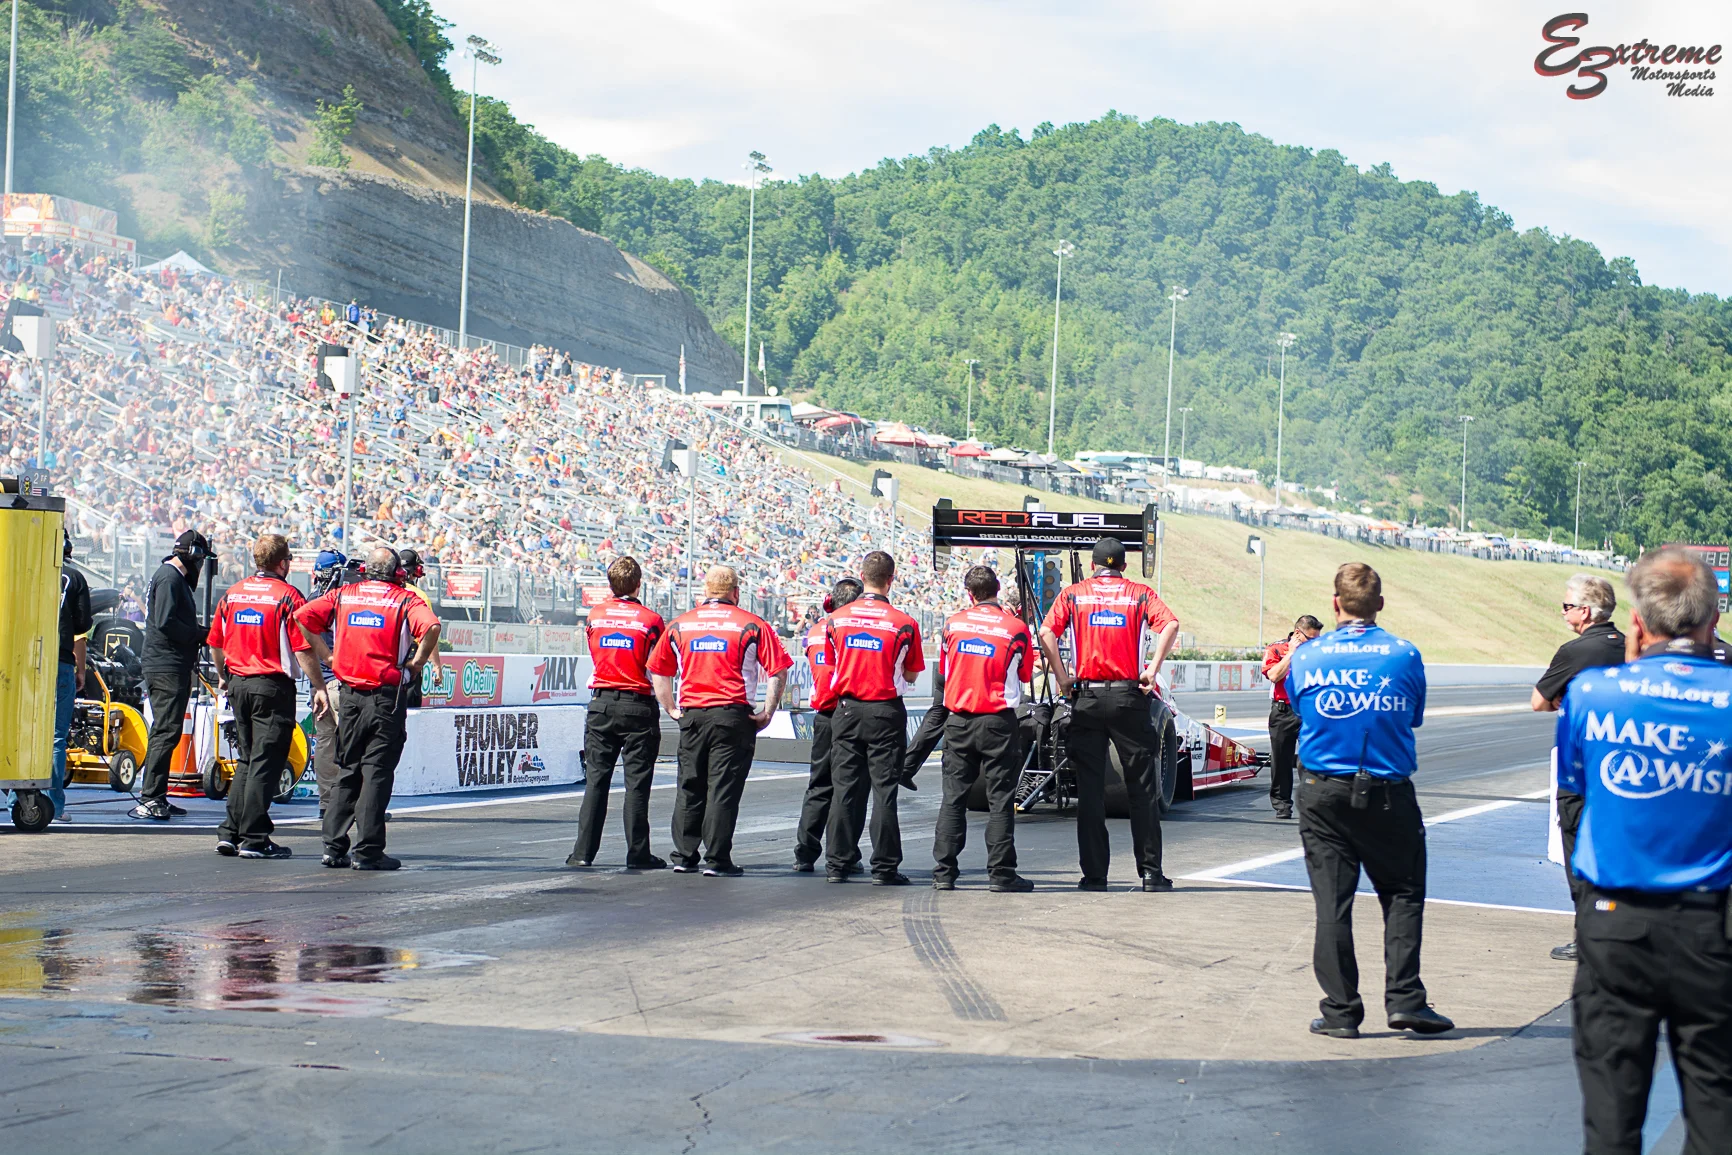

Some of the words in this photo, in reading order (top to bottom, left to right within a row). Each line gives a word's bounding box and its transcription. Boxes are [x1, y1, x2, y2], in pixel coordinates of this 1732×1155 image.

[1321, 641, 1391, 655] wish.org
[463, 661, 499, 698] O'Reilly
[1619, 678, 1730, 708] wish.org
[454, 712, 538, 752] THUNDER
[456, 751, 517, 786] VALLEY
